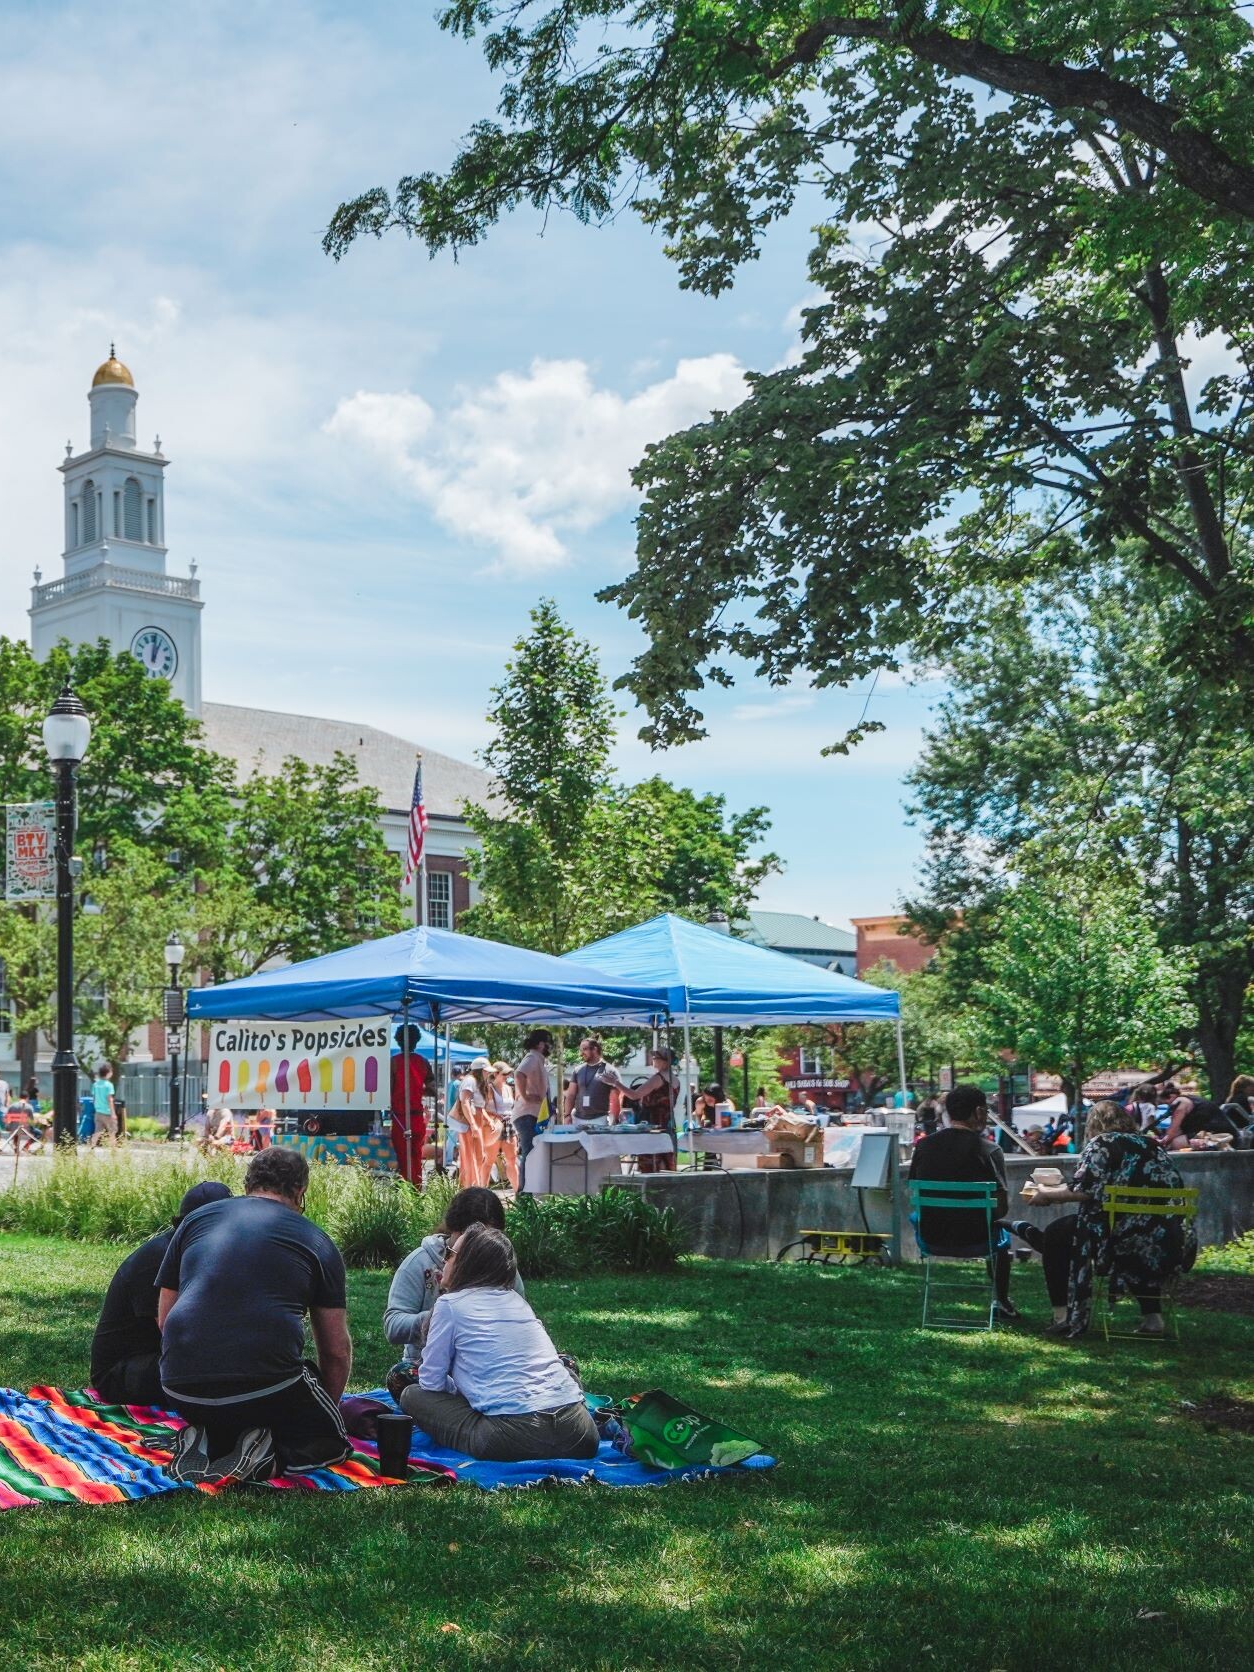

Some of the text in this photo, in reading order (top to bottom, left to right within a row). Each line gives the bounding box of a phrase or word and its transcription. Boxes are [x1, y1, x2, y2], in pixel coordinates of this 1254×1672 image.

[17, 833, 45, 846] BTV
[18, 845, 45, 858] MKT
[215, 1023, 388, 1057] Calito's Popsicles
[834, 1079, 850, 1088] SHOP
